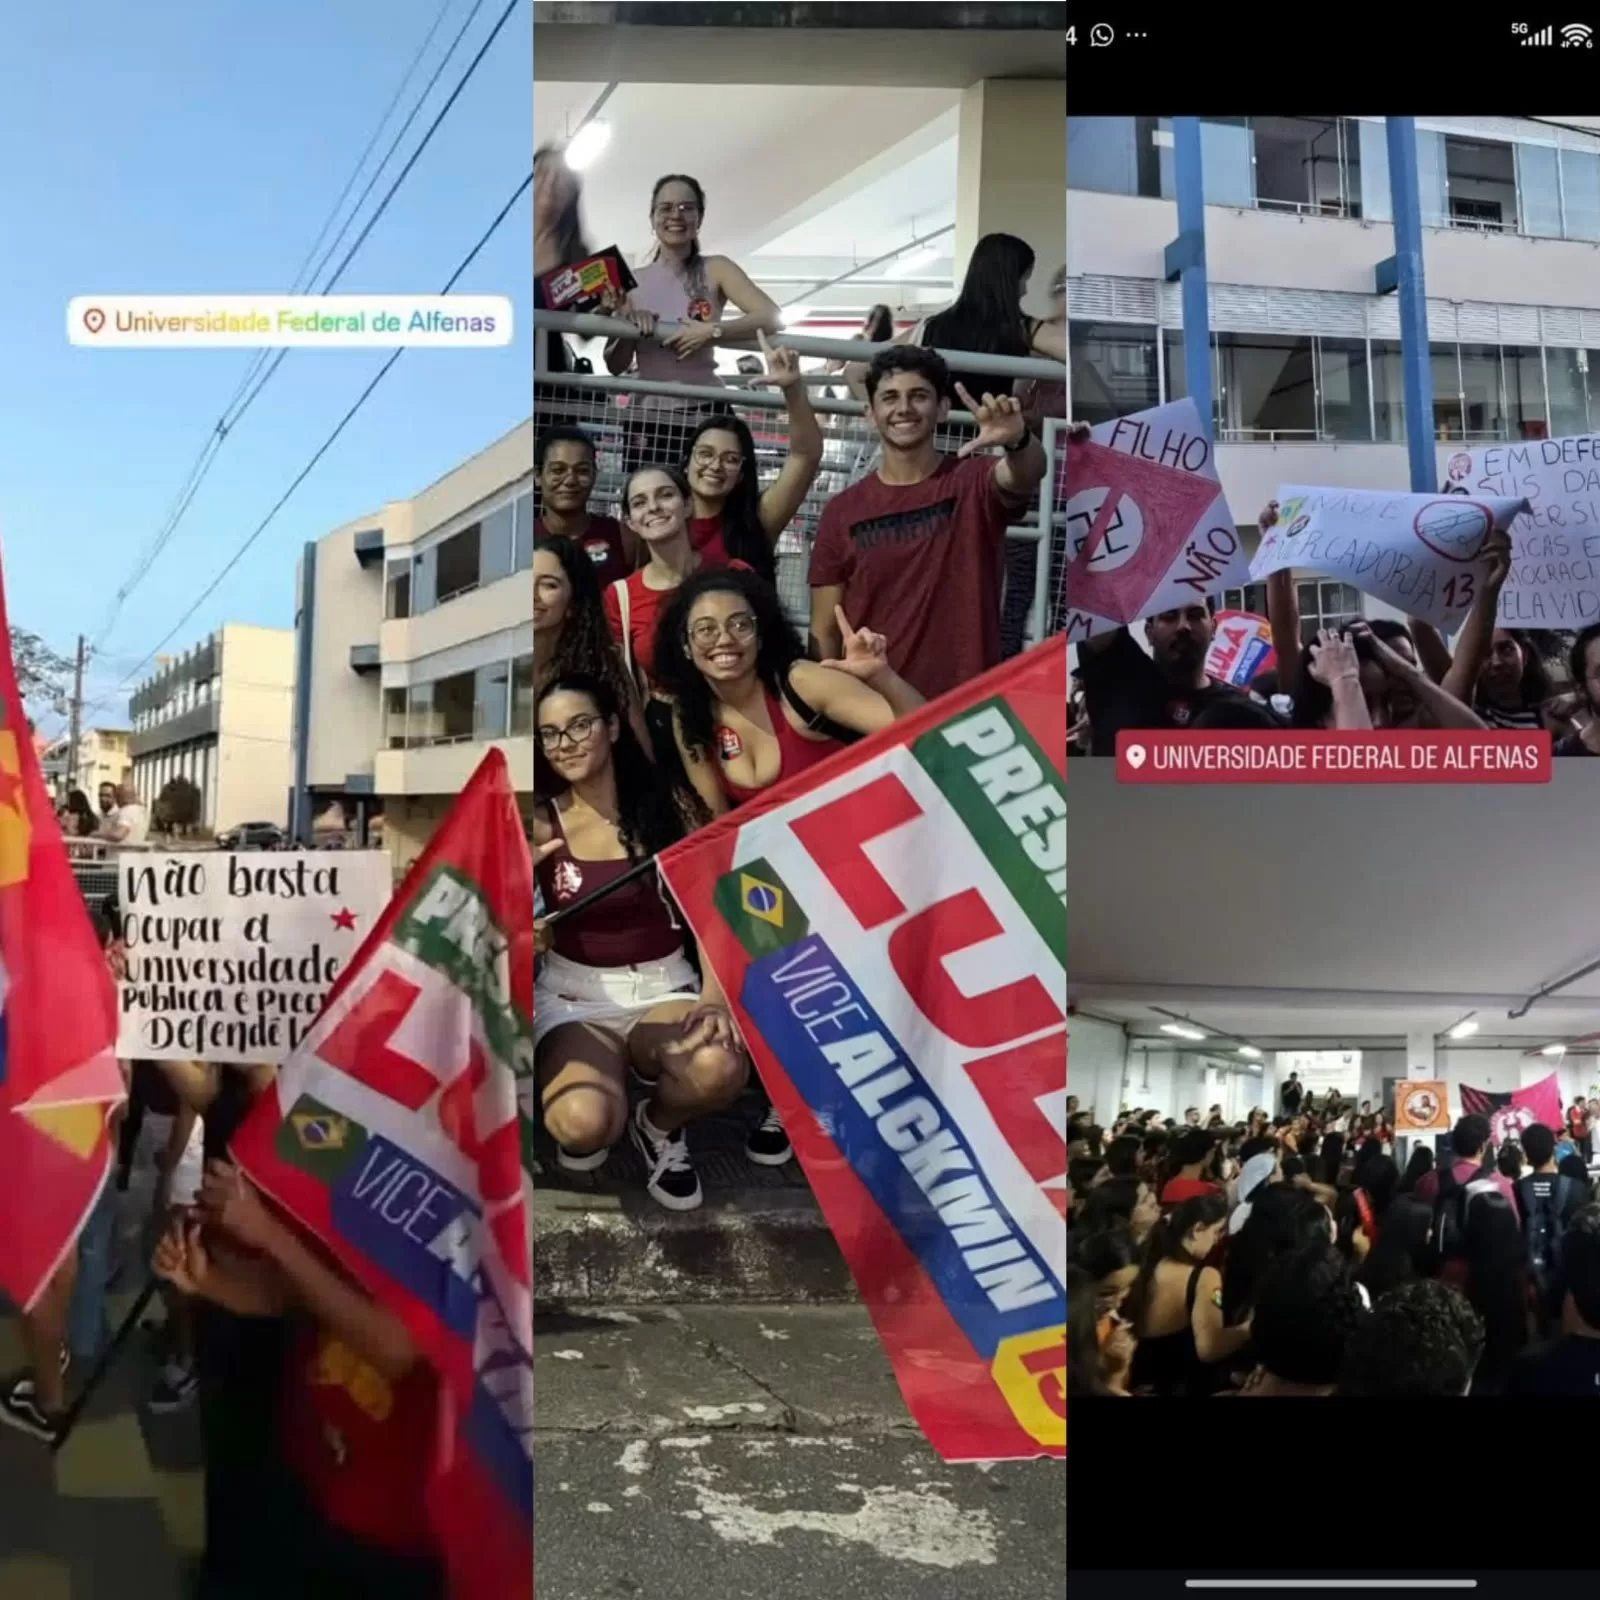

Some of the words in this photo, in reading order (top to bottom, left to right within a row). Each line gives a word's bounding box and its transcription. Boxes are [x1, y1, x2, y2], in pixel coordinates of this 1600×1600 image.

[1110, 419, 1208, 471] FILHO
[1485, 448, 1531, 476] EM
[1174, 527, 1237, 593] NÃO
[1443, 573, 1475, 608] 13
[1498, 590, 1547, 620] ELA
[229, 855, 340, 898] basta
[244, 913, 272, 943] a
[771, 945, 869, 1044] VICE
[788, 772, 1067, 1222] LUL
[351, 1145, 456, 1244] VICE
[819, 1030, 1058, 1313] ALCKMIN
